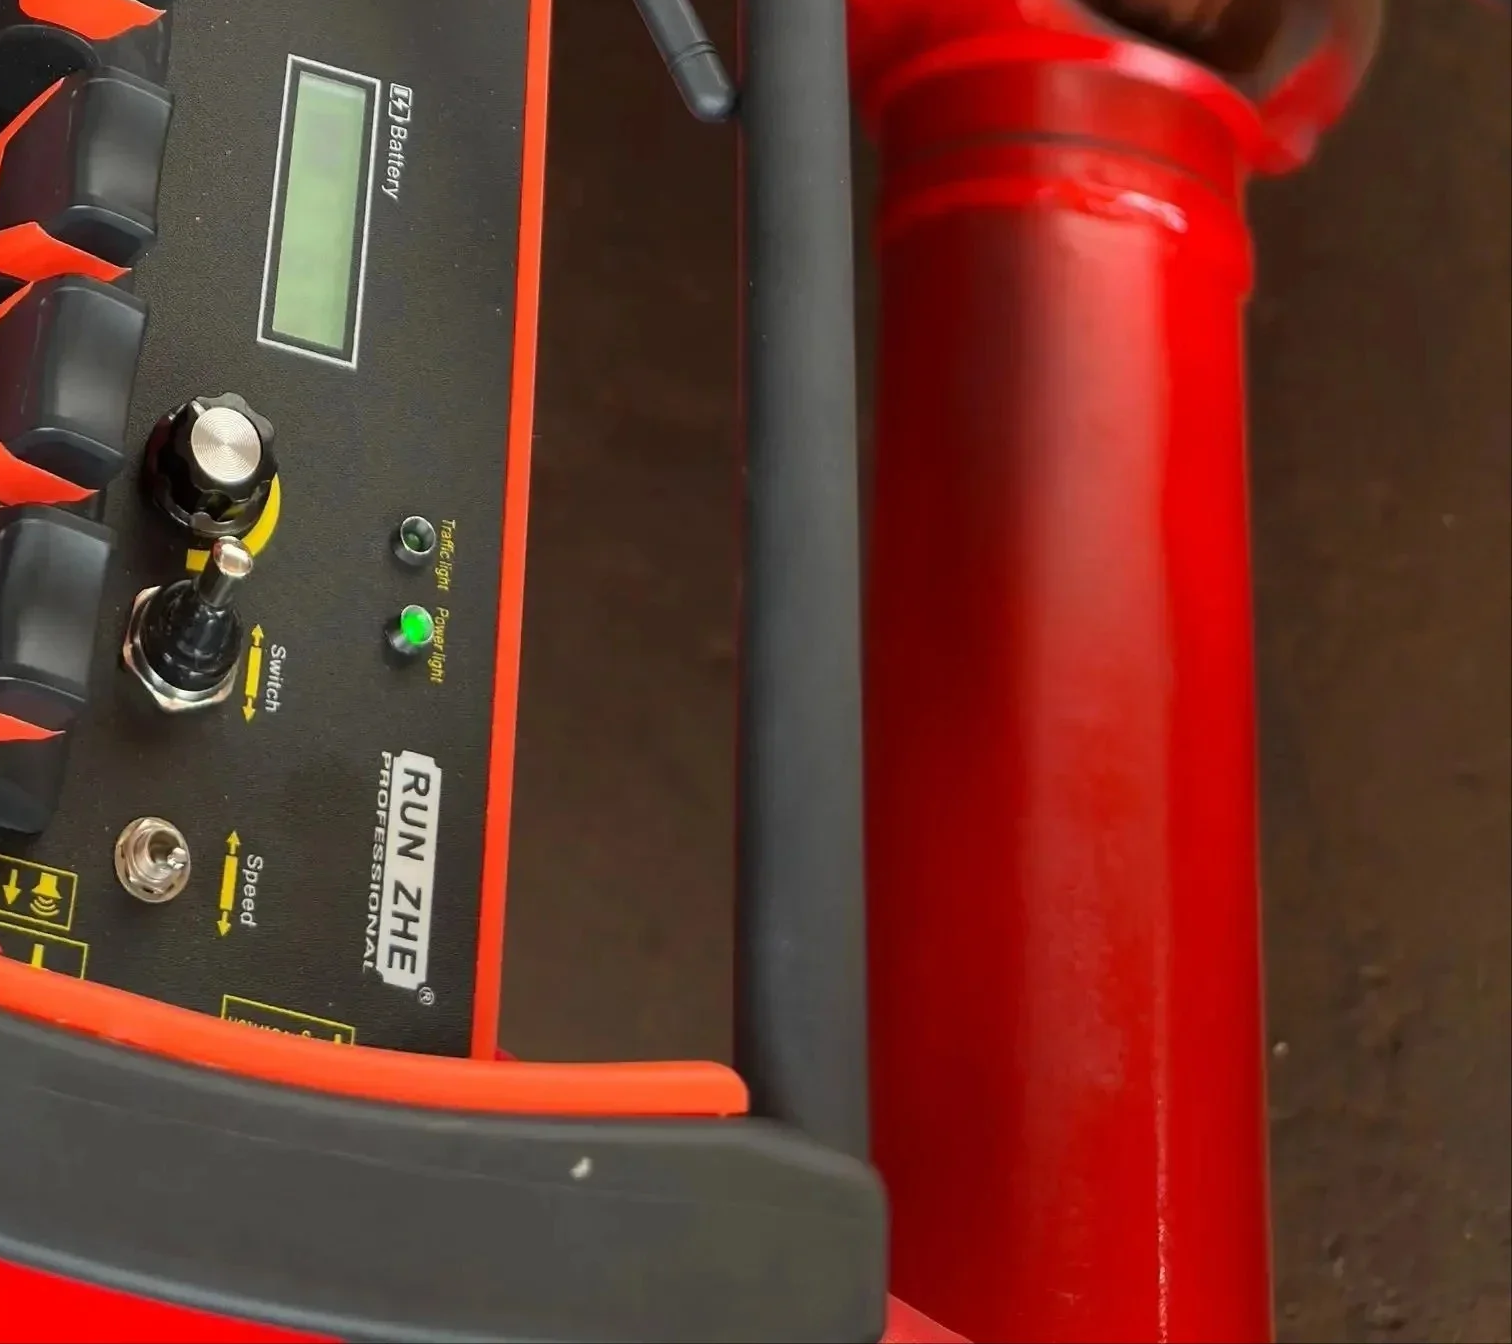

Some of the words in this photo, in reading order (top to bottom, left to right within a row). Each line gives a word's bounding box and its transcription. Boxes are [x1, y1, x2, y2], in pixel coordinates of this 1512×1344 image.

[381, 124, 409, 201] Battery
[434, 558, 450, 592] light
[439, 519, 457, 560] Traffic
[434, 606, 450, 653] Power
[264, 643, 287, 714] Switch
[427, 650, 446, 684] light
[395, 766, 432, 863] RUN
[239, 853, 264, 928] Speed
[361, 750, 393, 974] PROFESSIONAL
[385, 877, 423, 976] ZHE
